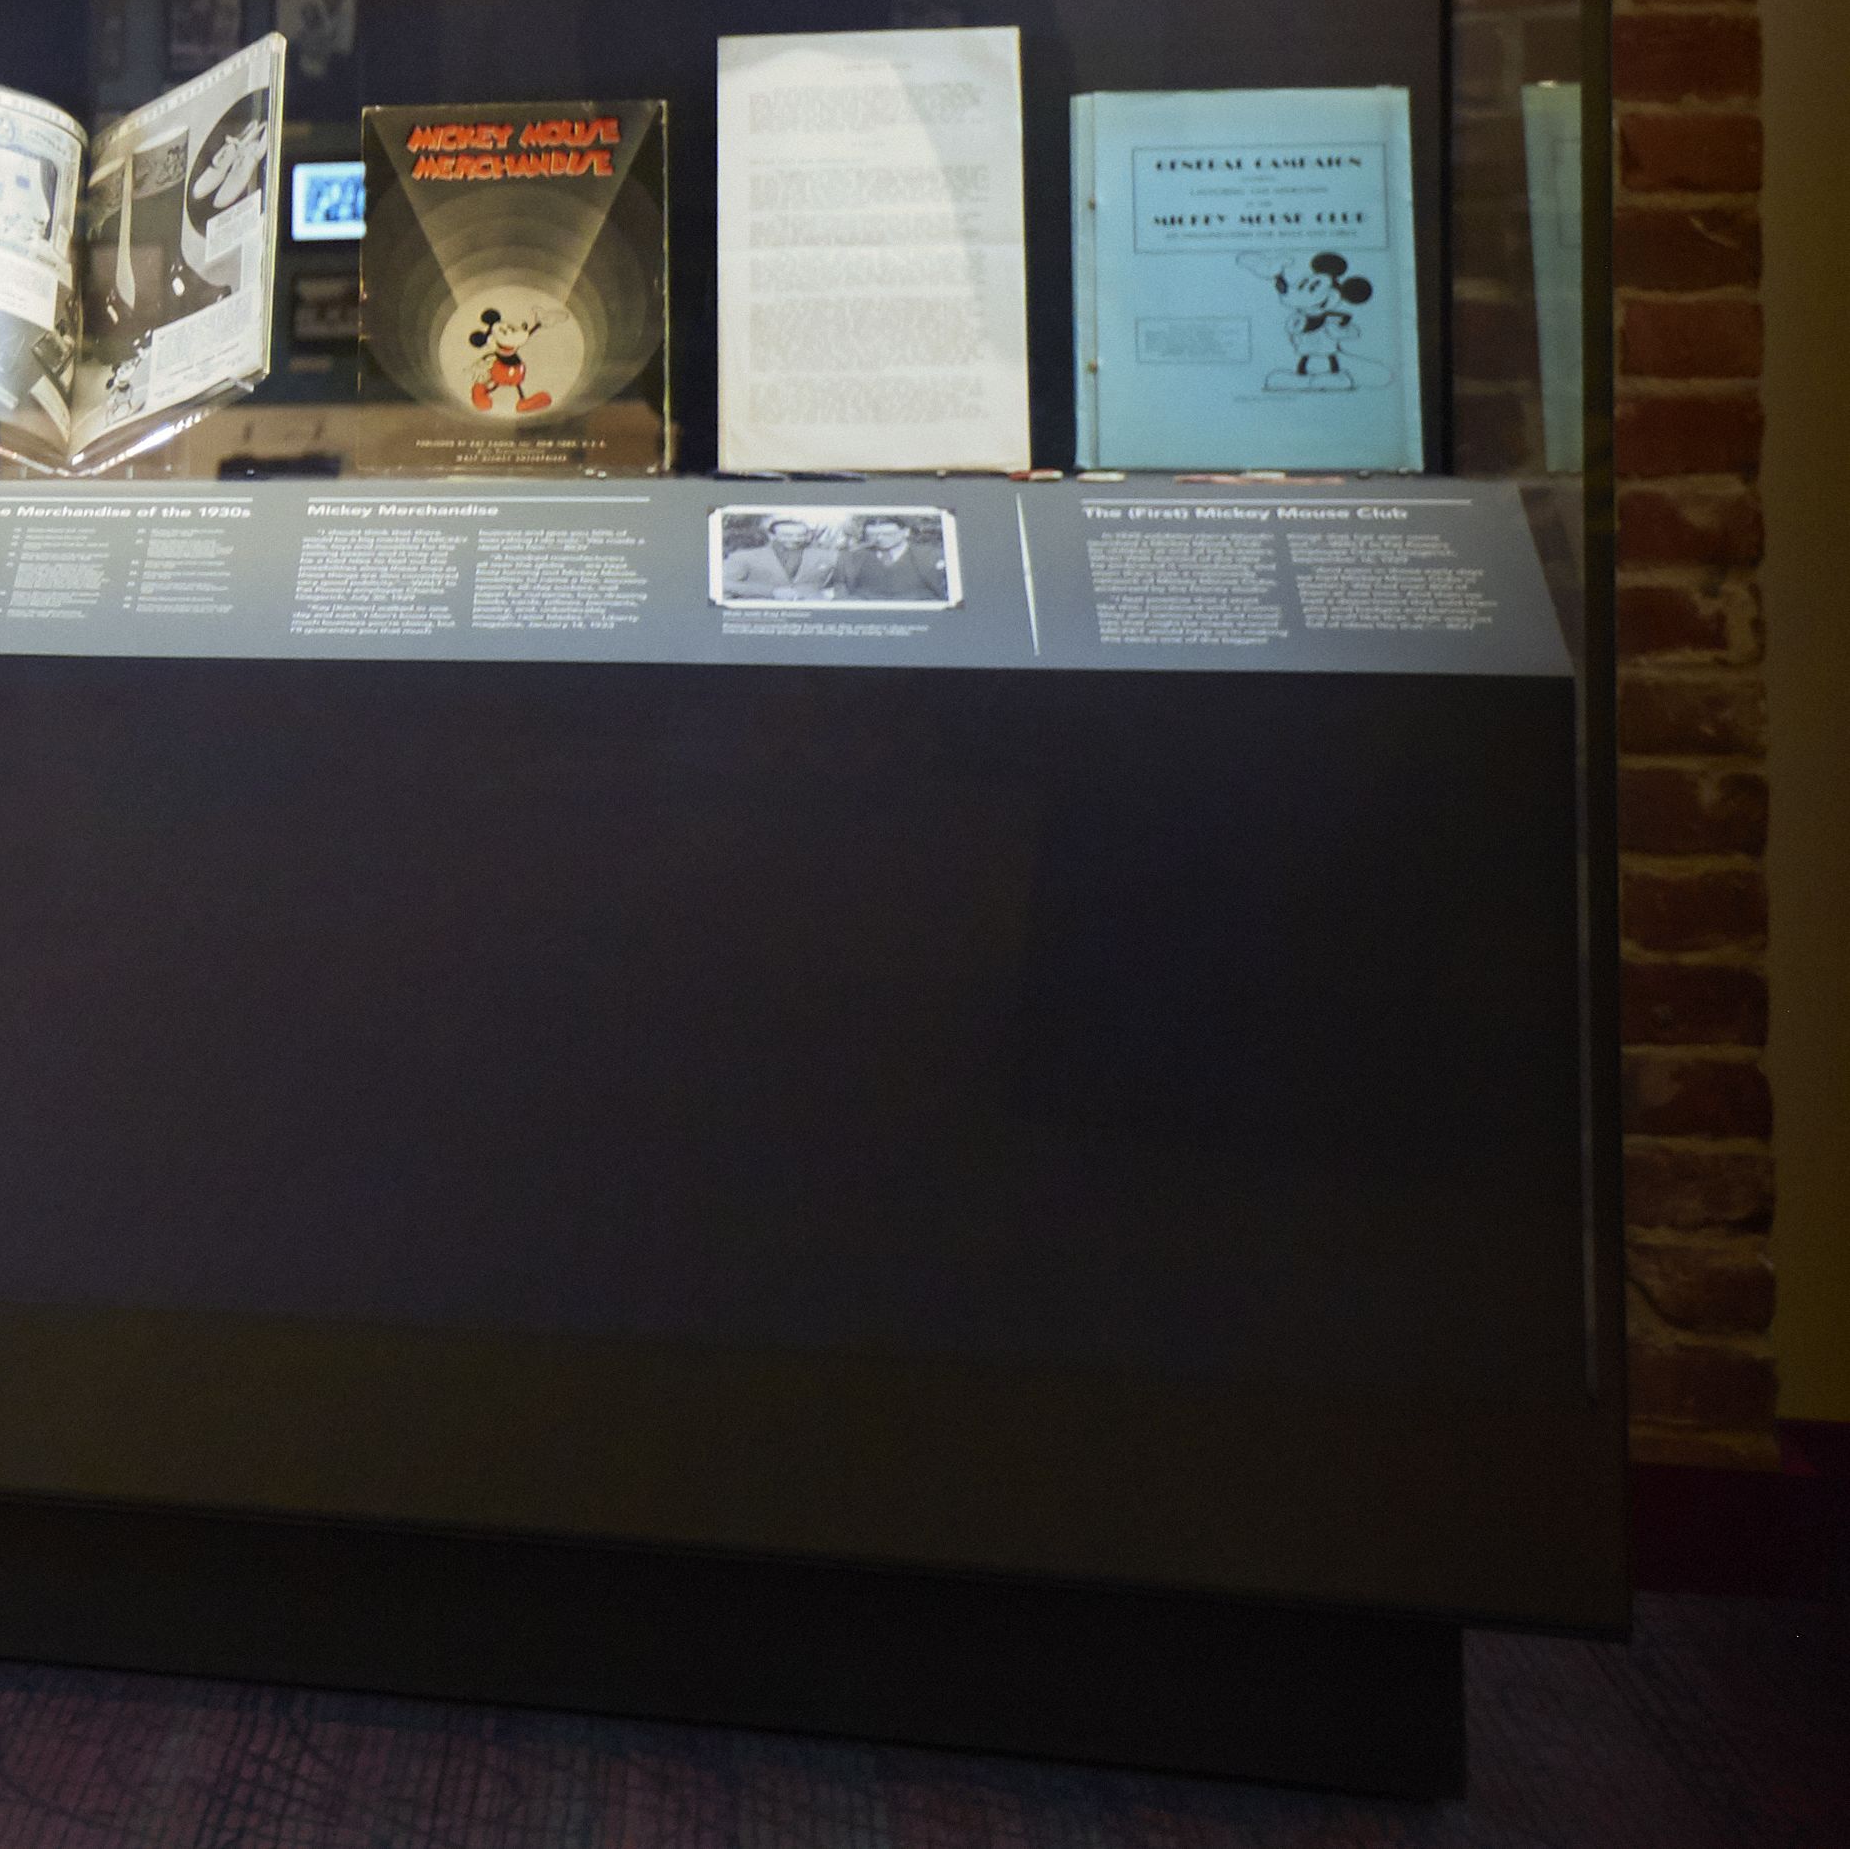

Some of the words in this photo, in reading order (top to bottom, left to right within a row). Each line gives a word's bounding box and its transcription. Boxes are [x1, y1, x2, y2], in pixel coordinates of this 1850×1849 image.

[407, 123, 514, 153] MICKEY
[519, 118, 621, 149] MOUSE
[413, 149, 614, 180] MERCHANDISE
[16, 504, 132, 517] Merchandise
[136, 504, 158, 517] of
[161, 504, 192, 517] the
[198, 505, 252, 518] 1930s
[307, 504, 373, 519] Mickey
[378, 504, 499, 517] Merchandise
[1083, 507, 1123, 520] The
[1128, 507, 1189, 521] (First)
[1196, 506, 1271, 521] Mickey
[1276, 506, 1350, 520] Mouse
[1356, 506, 1409, 520] Club
